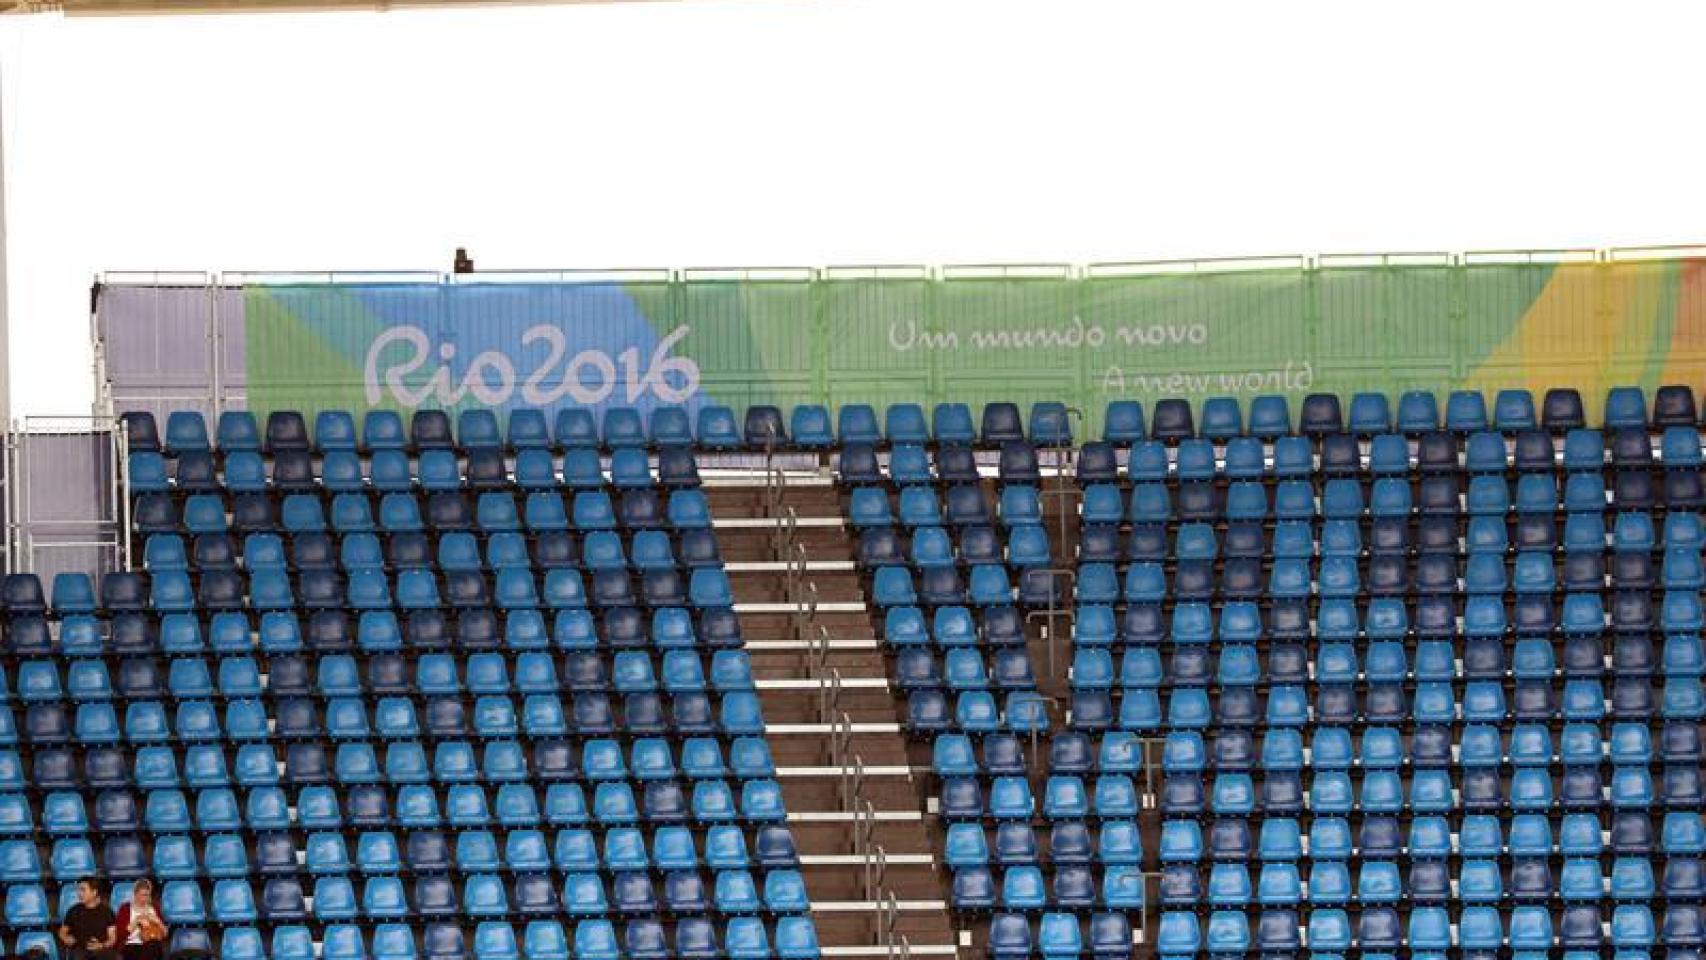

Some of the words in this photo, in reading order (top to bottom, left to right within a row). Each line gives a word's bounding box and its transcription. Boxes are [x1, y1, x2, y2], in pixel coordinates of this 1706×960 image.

[889, 320, 958, 351] Um
[972, 315, 1104, 347] mundo
[1118, 322, 1207, 345] novo
[1103, 365, 1126, 394] A
[1134, 373, 1211, 394] new
[1219, 360, 1314, 392] world
